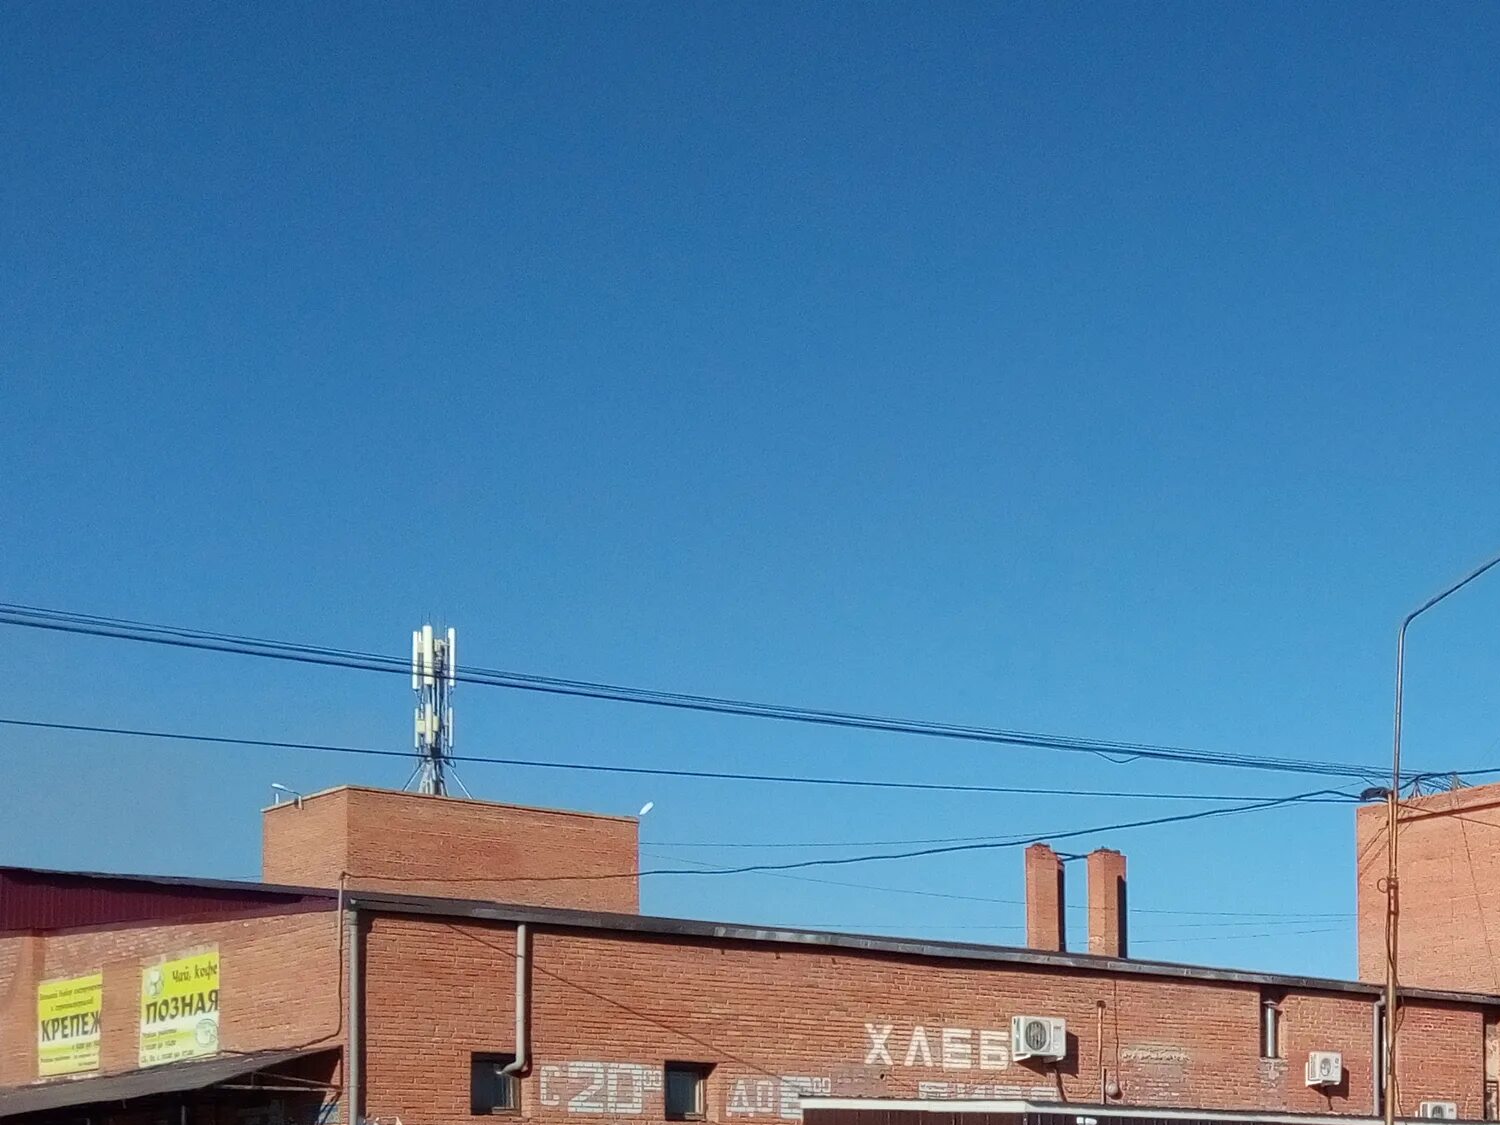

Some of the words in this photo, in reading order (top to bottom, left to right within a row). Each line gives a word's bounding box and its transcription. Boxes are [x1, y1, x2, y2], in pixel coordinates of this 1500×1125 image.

[194, 961, 218, 980] кофе
[146, 989, 219, 1024] ПОЗНАЯ
[41, 1010, 102, 1041] КРЕПЕЖ
[864, 1023, 1010, 1071] ХЛЕБ
